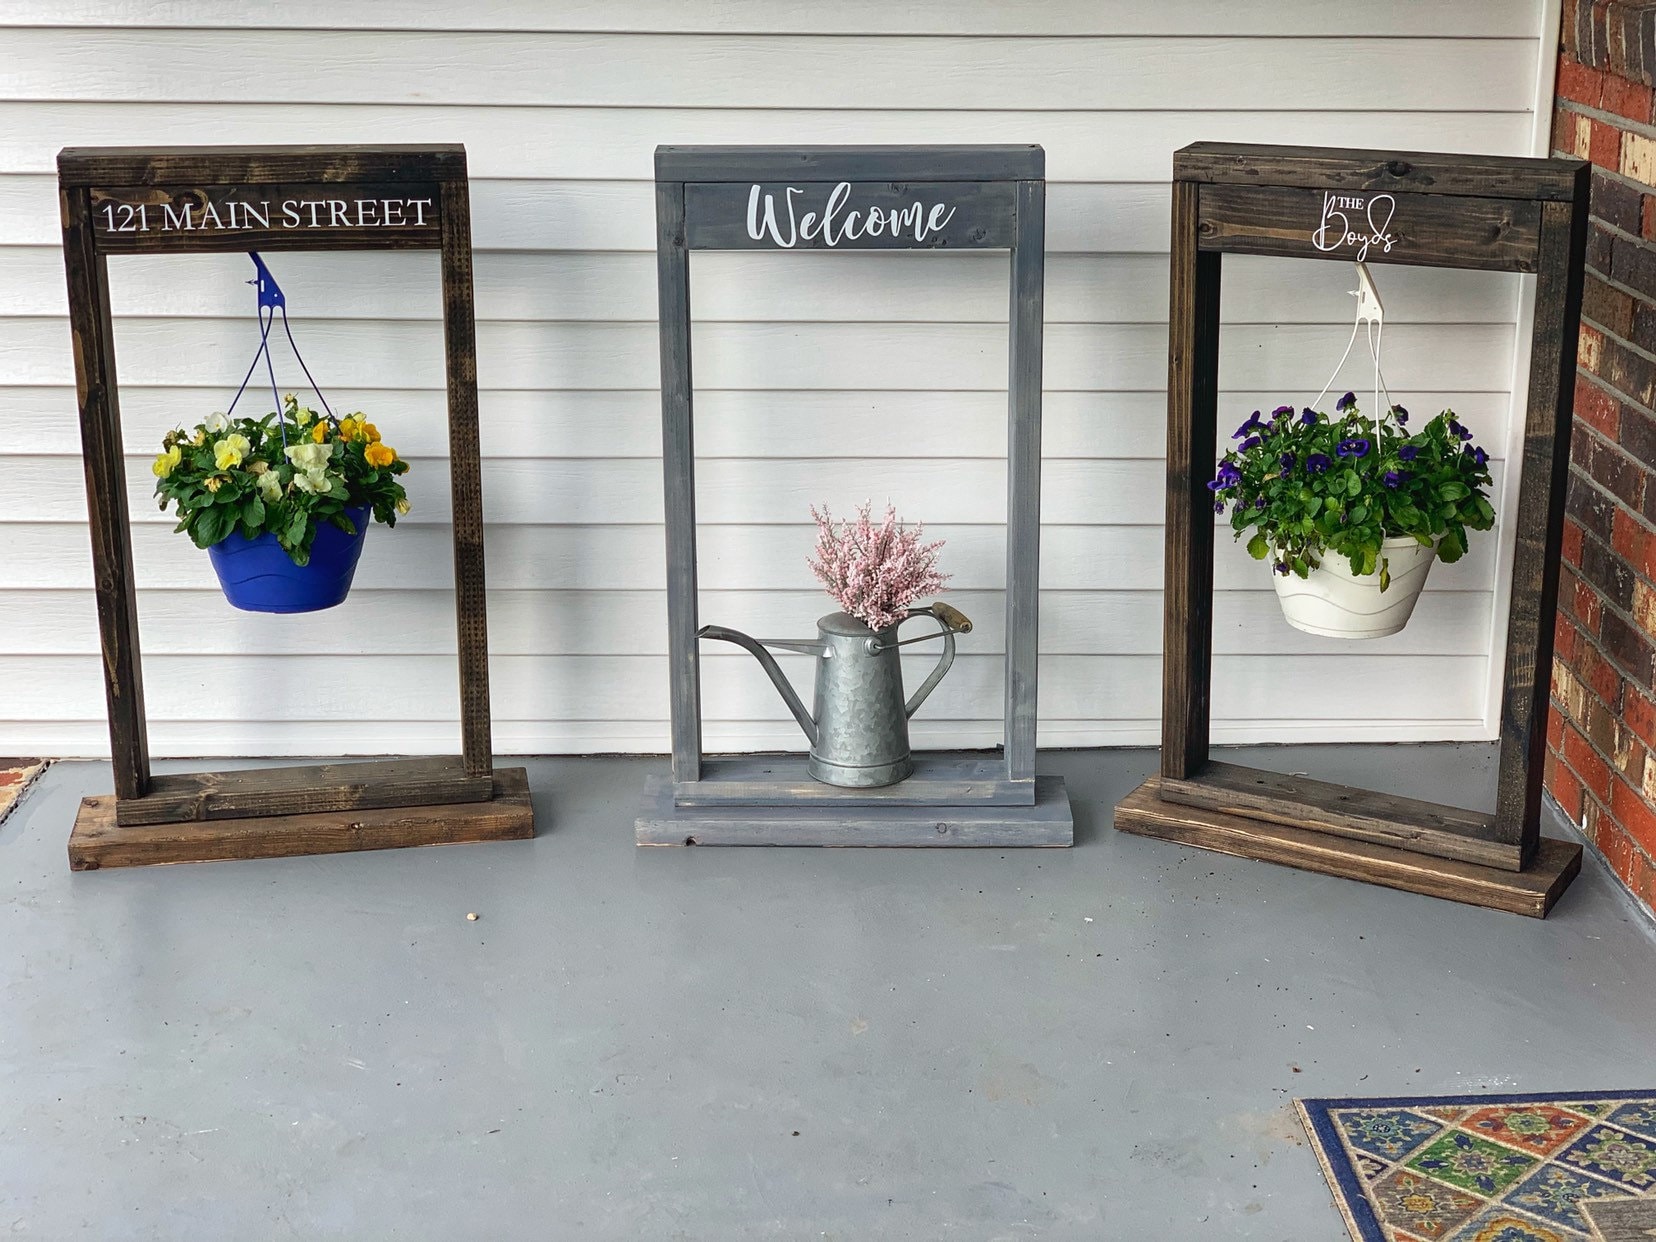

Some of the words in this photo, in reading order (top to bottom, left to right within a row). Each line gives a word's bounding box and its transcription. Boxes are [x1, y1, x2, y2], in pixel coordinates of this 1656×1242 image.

[102, 204, 150, 233] 121
[160, 200, 270, 232] MAIN
[282, 198, 432, 229] STREET
[746, 181, 956, 247] Welcome
[1312, 190, 1398, 262] Boyds
[1337, 196, 1365, 210] THE
